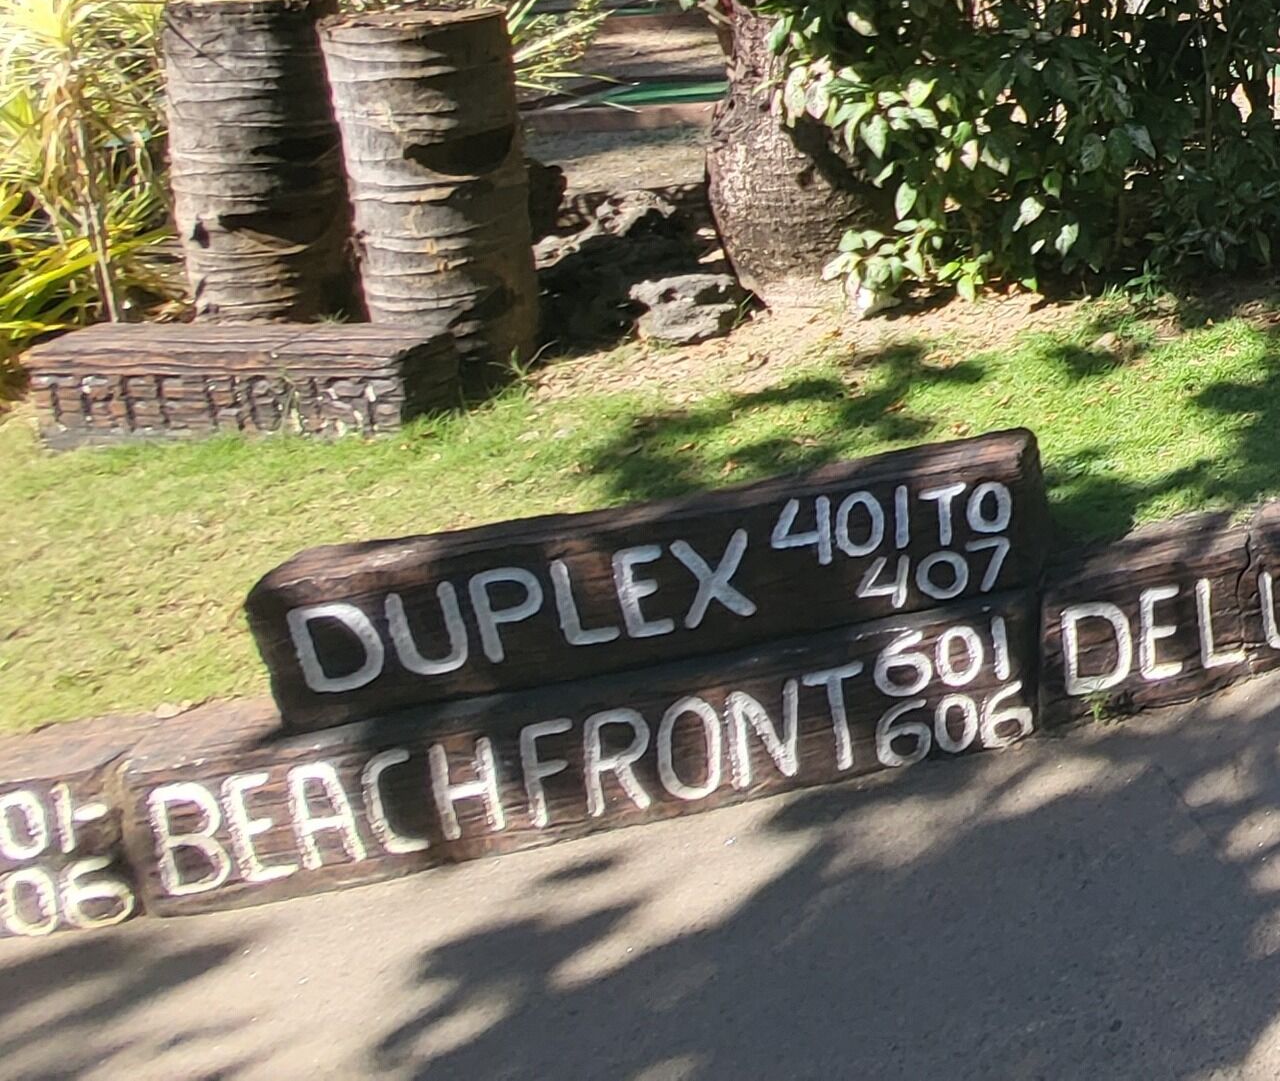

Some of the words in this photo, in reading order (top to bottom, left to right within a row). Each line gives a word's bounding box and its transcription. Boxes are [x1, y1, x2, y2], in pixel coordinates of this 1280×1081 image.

[287, 528, 757, 694] DUPLEX
[855, 536, 1011, 609] 407
[147, 659, 864, 897] BEACHFRONT
[873, 616, 1011, 698] 601
[875, 680, 1035, 768] 606
